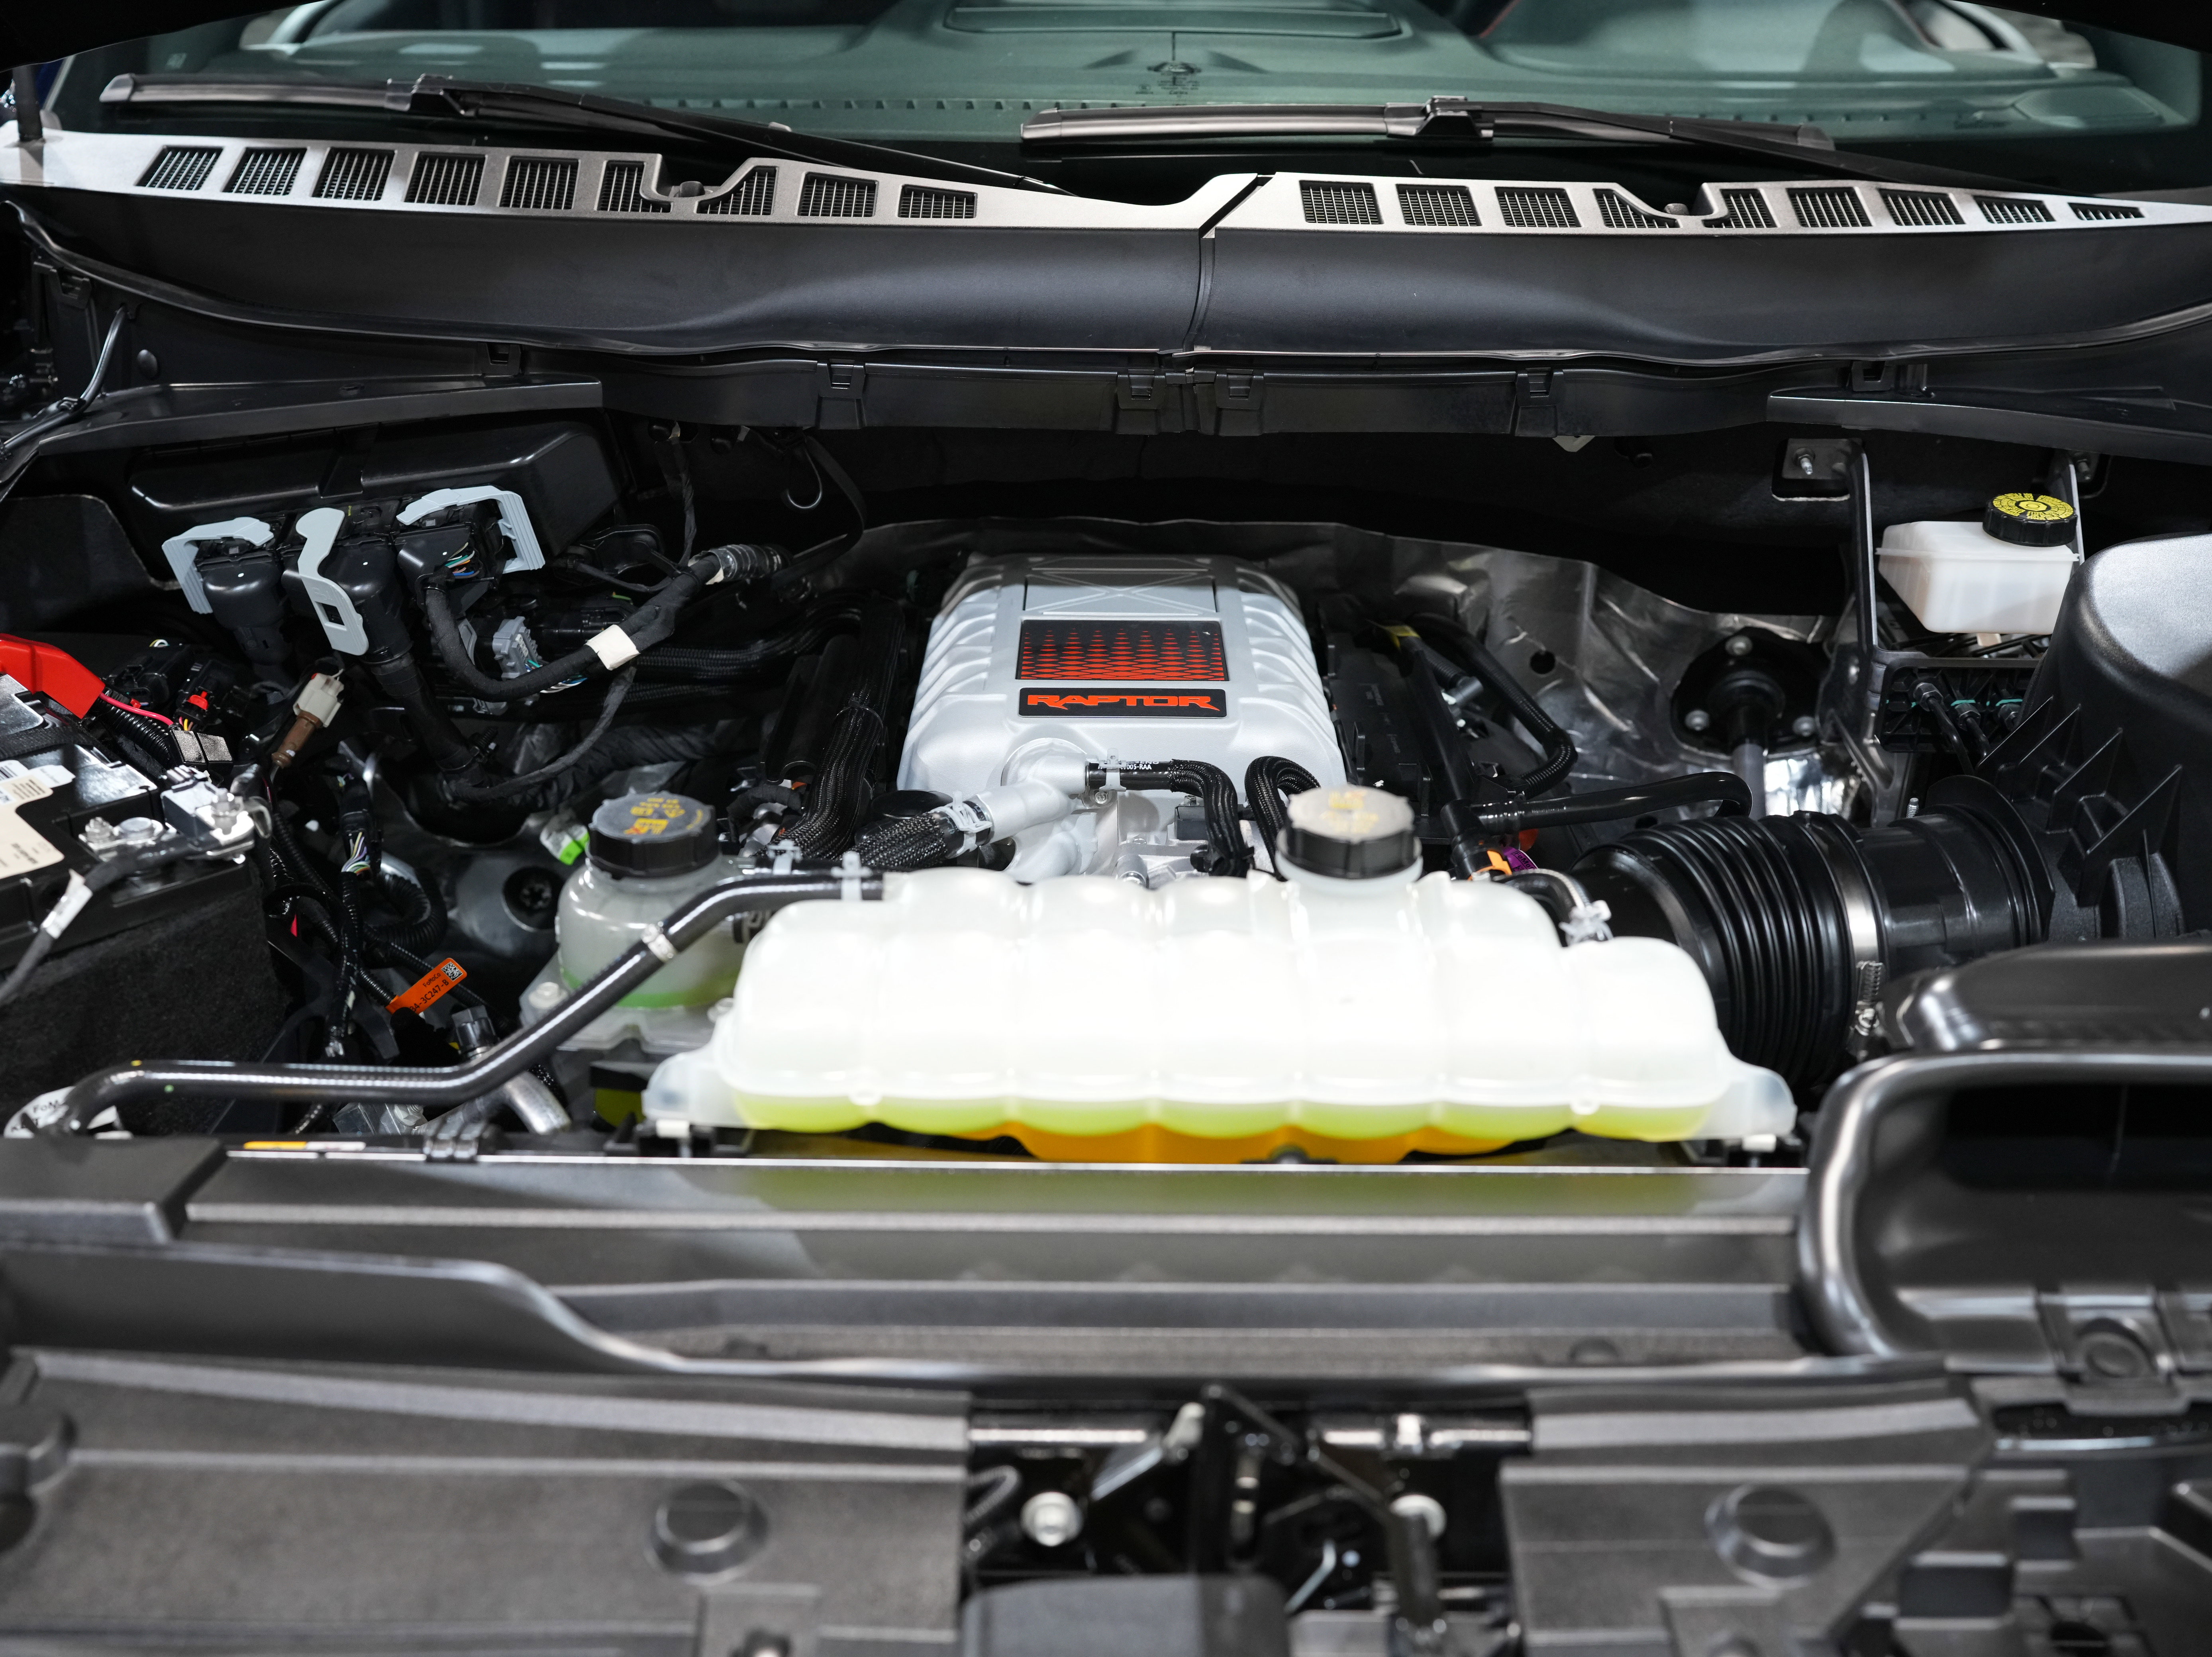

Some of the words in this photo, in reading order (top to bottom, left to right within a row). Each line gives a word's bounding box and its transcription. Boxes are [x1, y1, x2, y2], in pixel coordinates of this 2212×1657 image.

[1028, 694, 1220, 711] RAPTOR
[1514, 852, 1535, 869] FoMo
[422, 973, 441, 987] FoMoCo
[410, 979, 449, 1012] 34-3C247-B
